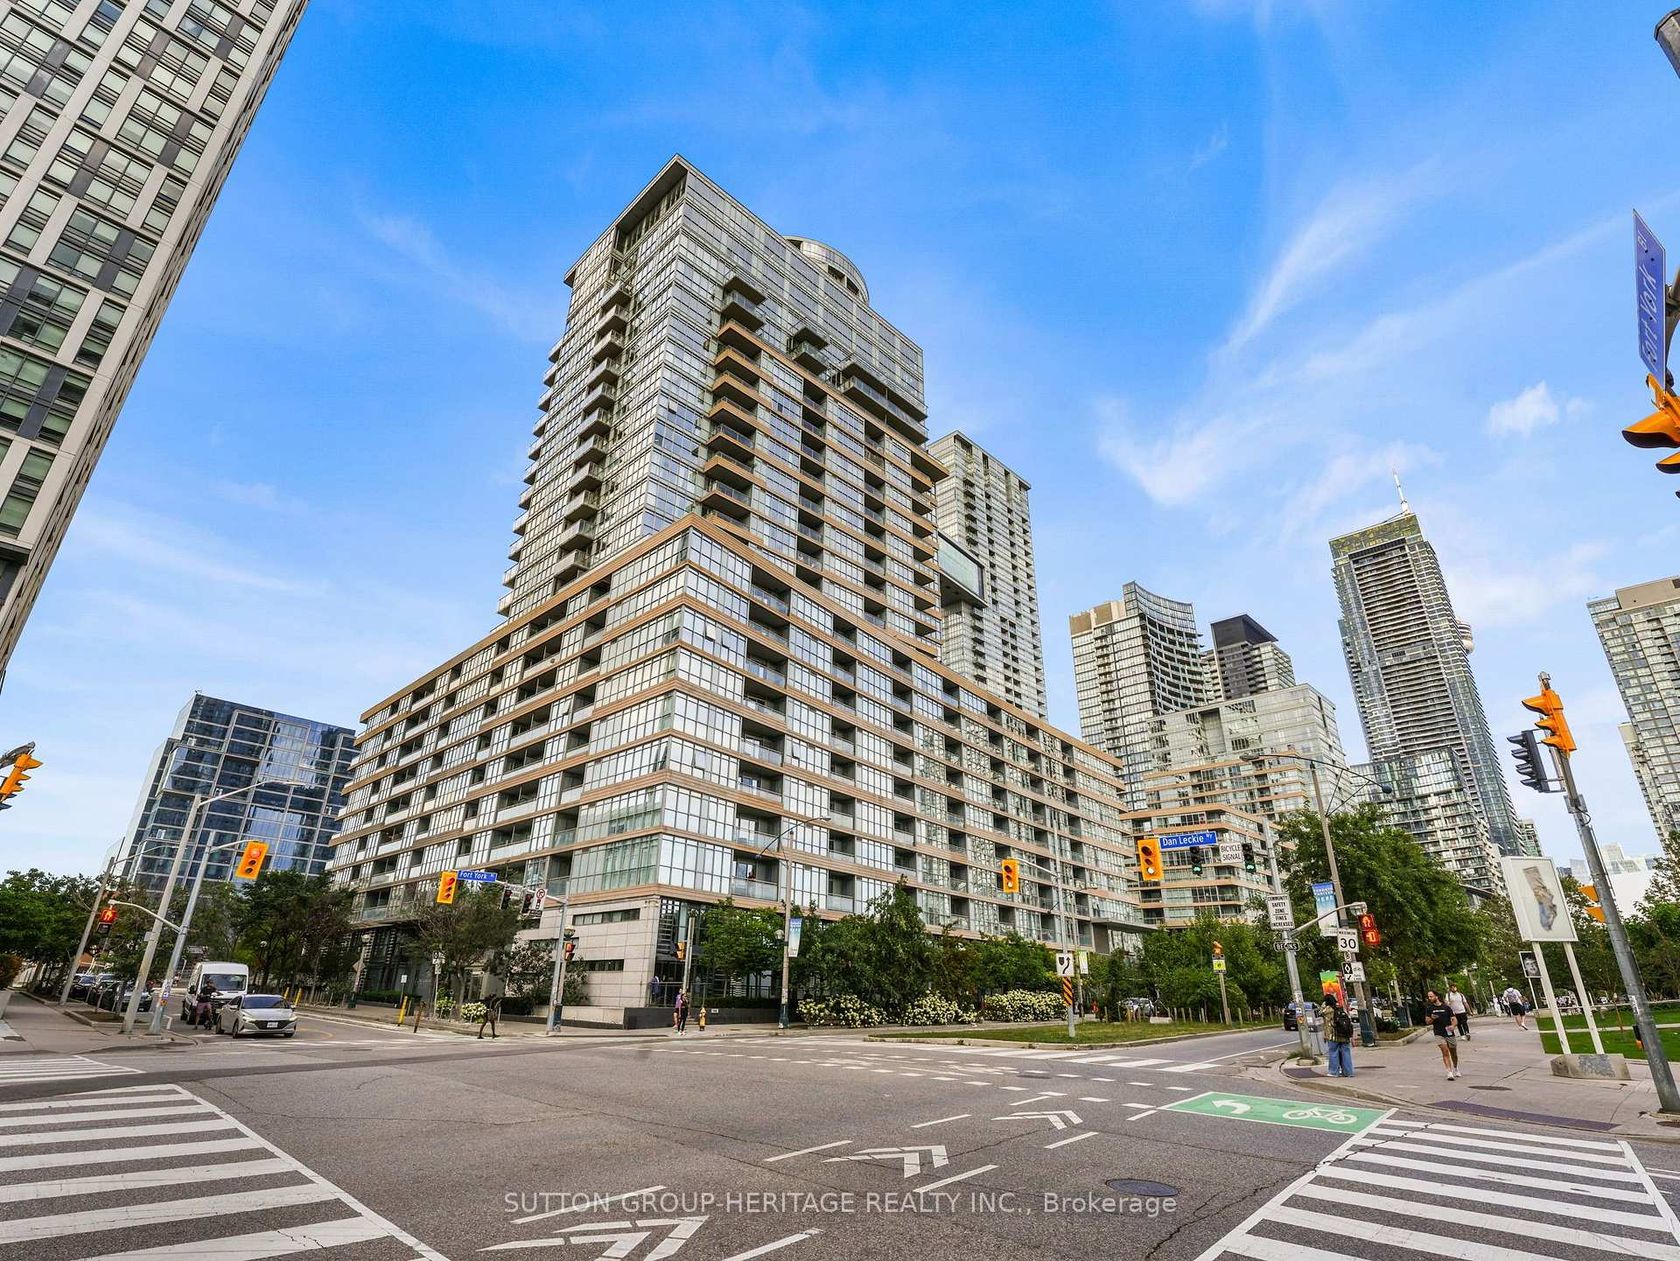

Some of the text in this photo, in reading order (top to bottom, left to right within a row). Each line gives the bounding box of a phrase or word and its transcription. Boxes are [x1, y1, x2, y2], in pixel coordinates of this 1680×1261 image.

[1639, 264, 1657, 322] York
[1641, 318, 1657, 373] Fort
[1162, 837, 1177, 846] Dan
[1179, 834, 1204, 845] Leckie
[1220, 844, 1241, 852] BICYCLE
[1222, 852, 1241, 861] SIGNAL
[460, 870, 473, 878] Fort
[474, 872, 487, 880] York
[1340, 937, 1357, 949] 30
